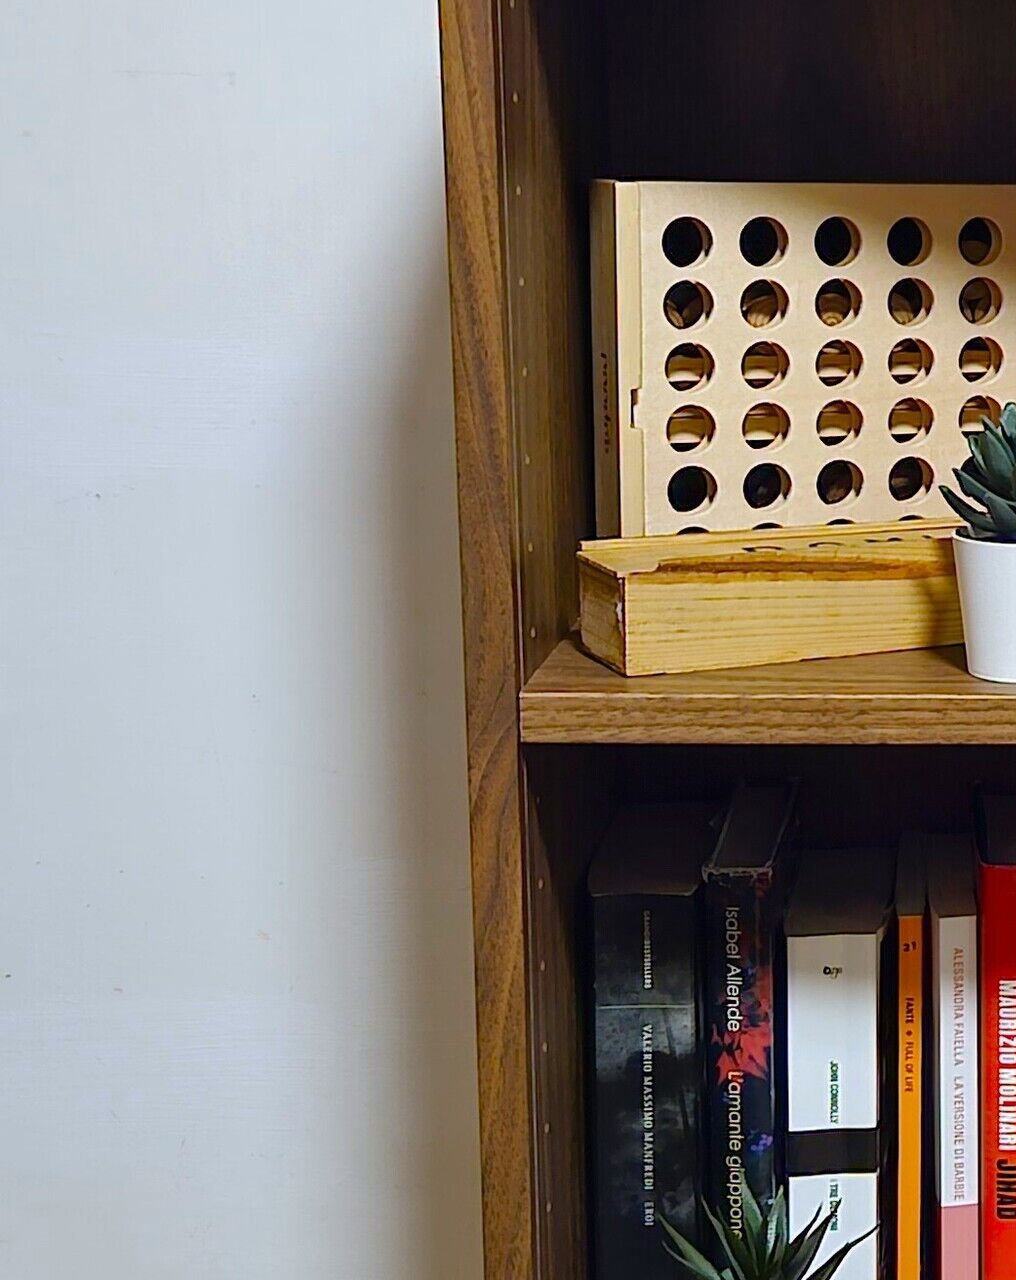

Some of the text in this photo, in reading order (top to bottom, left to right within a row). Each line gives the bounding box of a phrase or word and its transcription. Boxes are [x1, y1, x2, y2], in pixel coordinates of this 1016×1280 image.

[726, 906, 742, 959] Isabel
[725, 963, 743, 1032] Allende
[829, 1061, 839, 1083] JOHN
[903, 997, 915, 1093] FANTE FULL OF LIFE
[953, 947, 965, 1202] ALESSANDRA FAIELLA LA VERSIONE DI BARBIE
[643, 1024, 655, 1227] VALERIO MASSIMO MANFREDI EROI
[726, 1070, 744, 1150] L'amante
